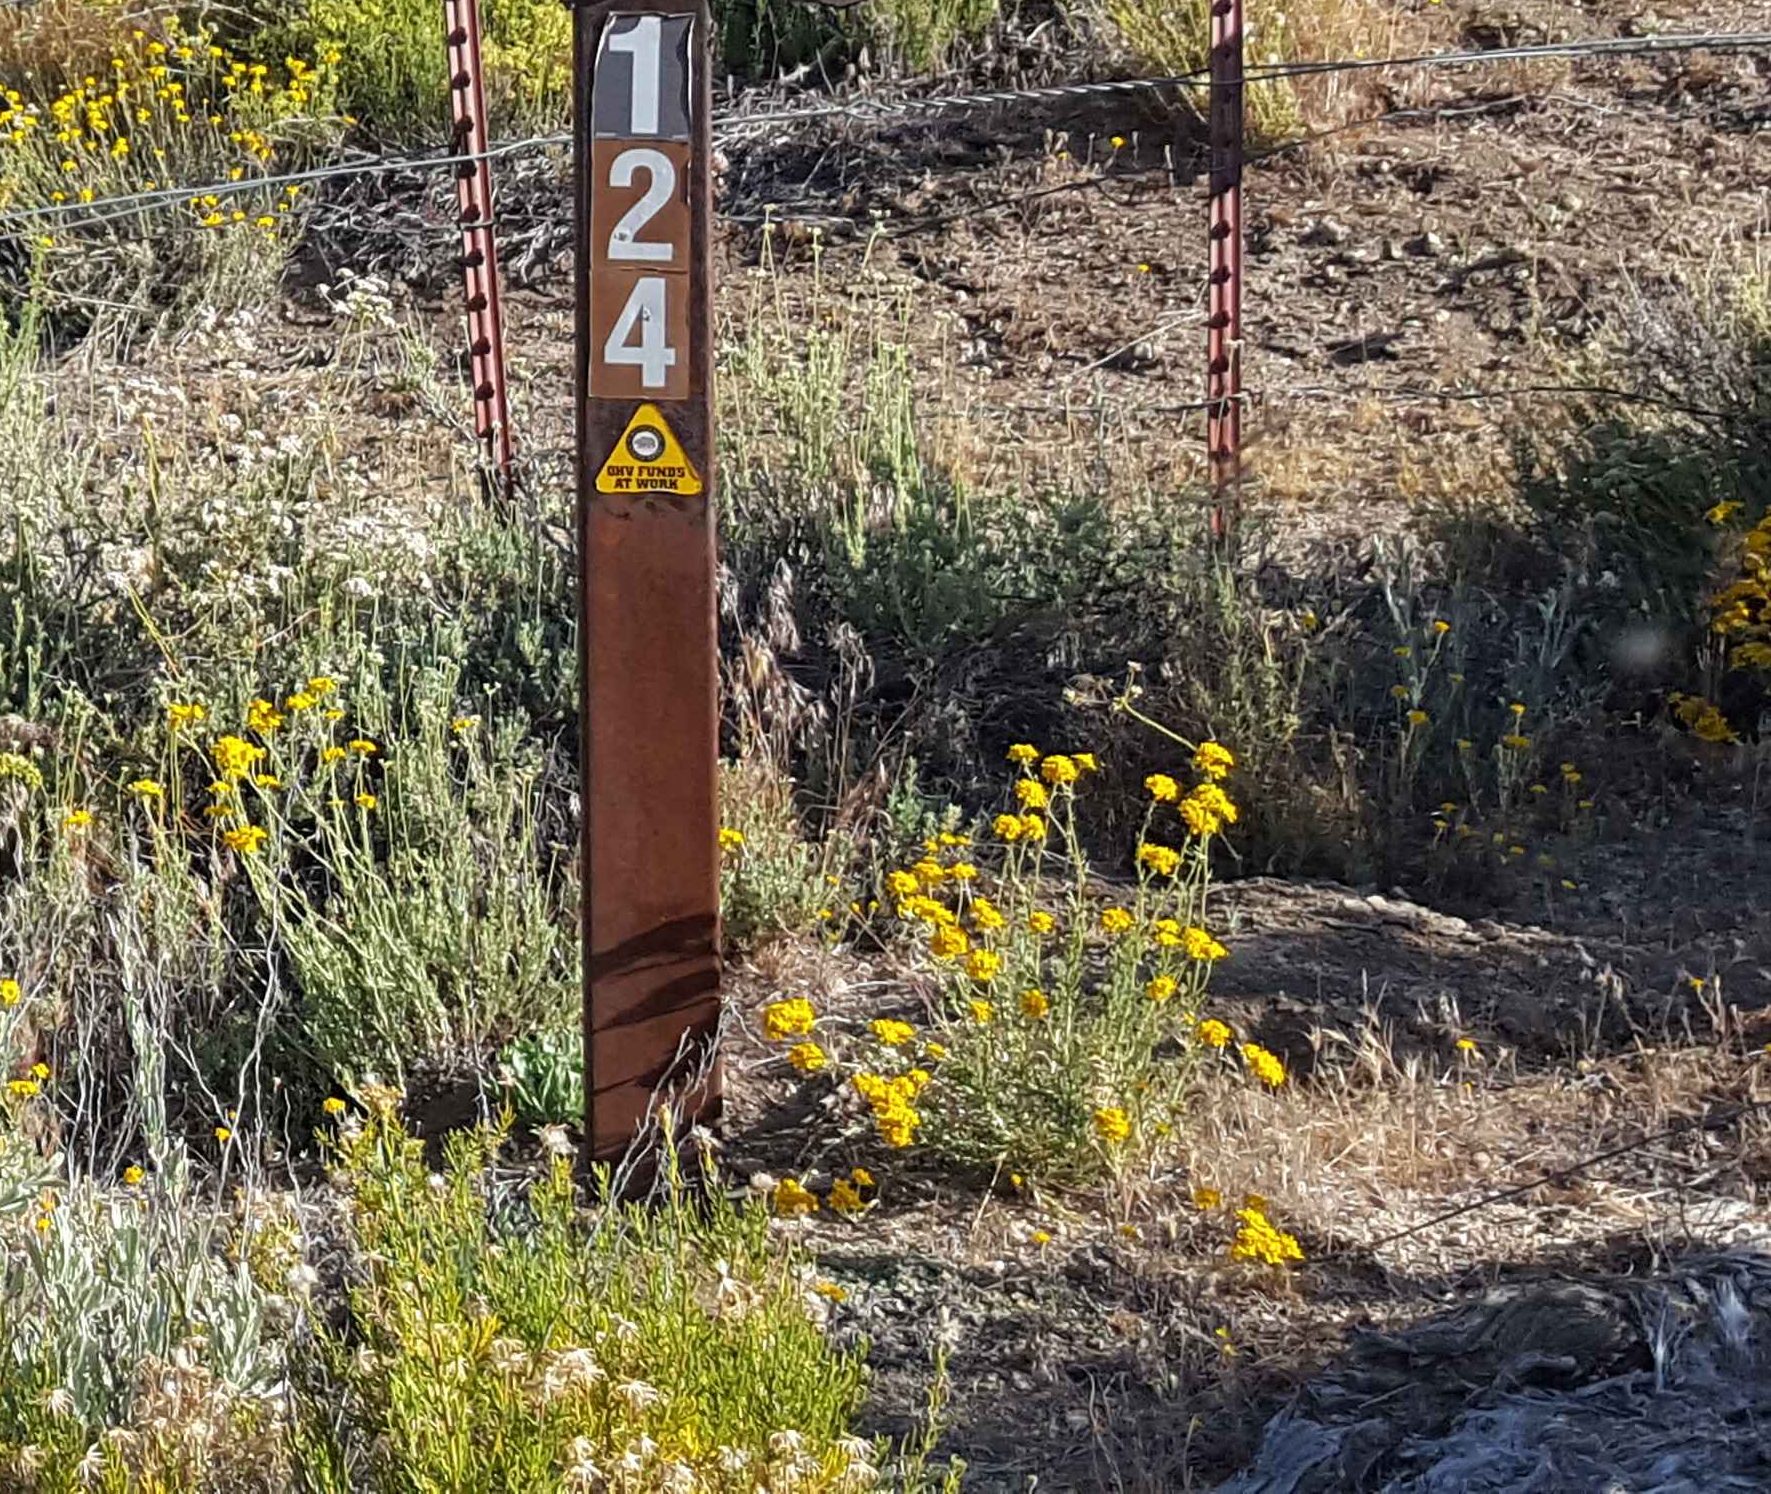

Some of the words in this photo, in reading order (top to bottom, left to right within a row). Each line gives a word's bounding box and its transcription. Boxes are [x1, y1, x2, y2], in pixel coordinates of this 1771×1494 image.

[607, 466, 634, 476] OHV
[638, 467, 685, 478] FUNDS
[614, 478, 632, 489] AT
[636, 478, 679, 489] WORK
